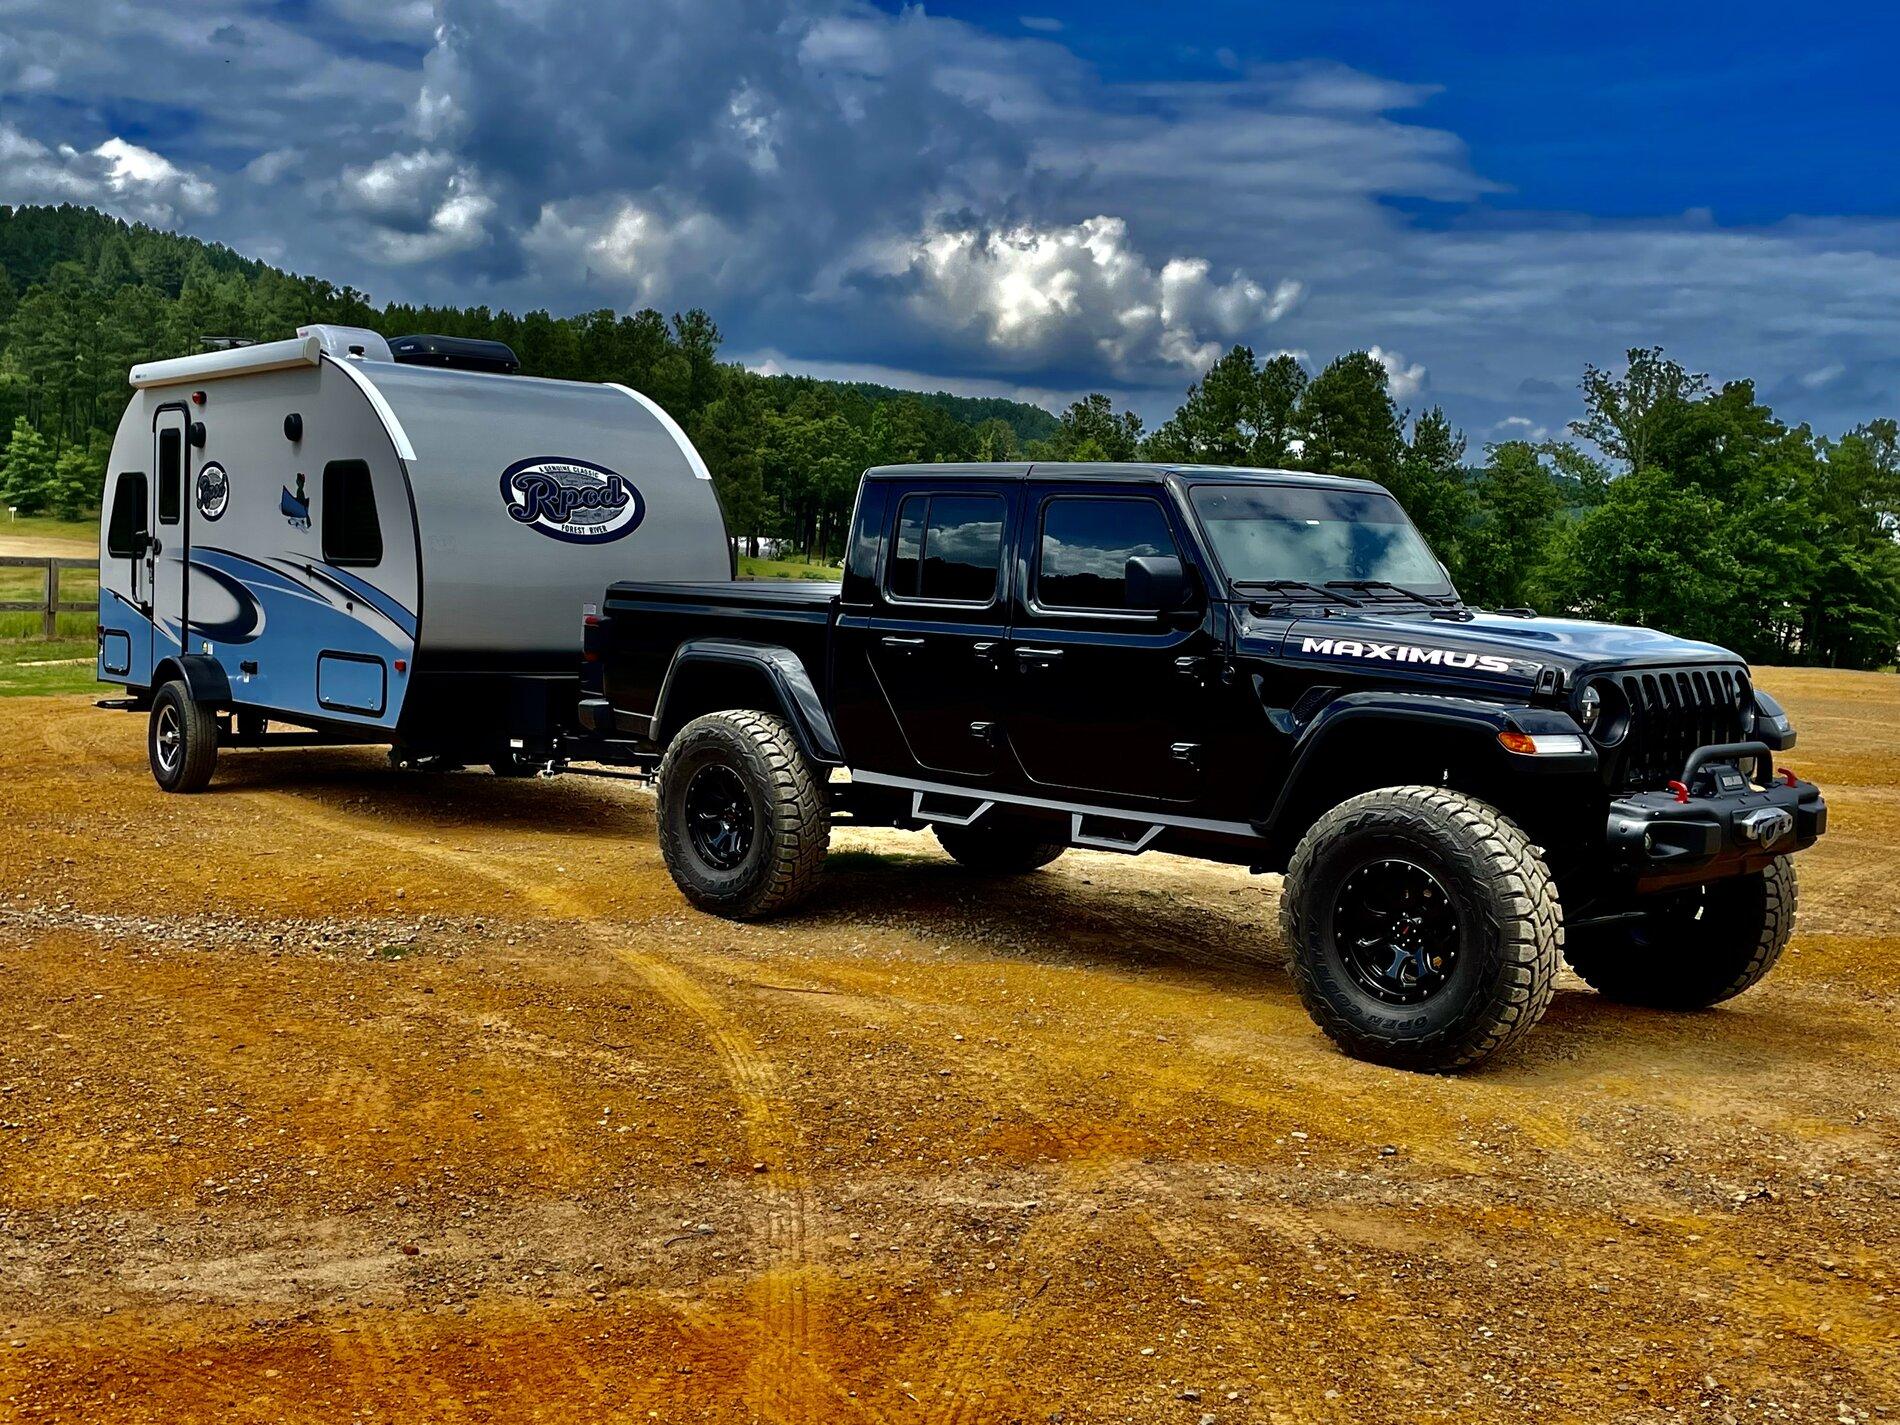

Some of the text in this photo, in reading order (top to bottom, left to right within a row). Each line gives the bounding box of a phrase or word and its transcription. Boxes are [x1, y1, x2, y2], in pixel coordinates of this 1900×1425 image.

[572, 467, 600, 478] CLASSIC
[561, 524, 608, 534] FOREST RIVER
[1302, 637, 1514, 672] MAXIMUS
